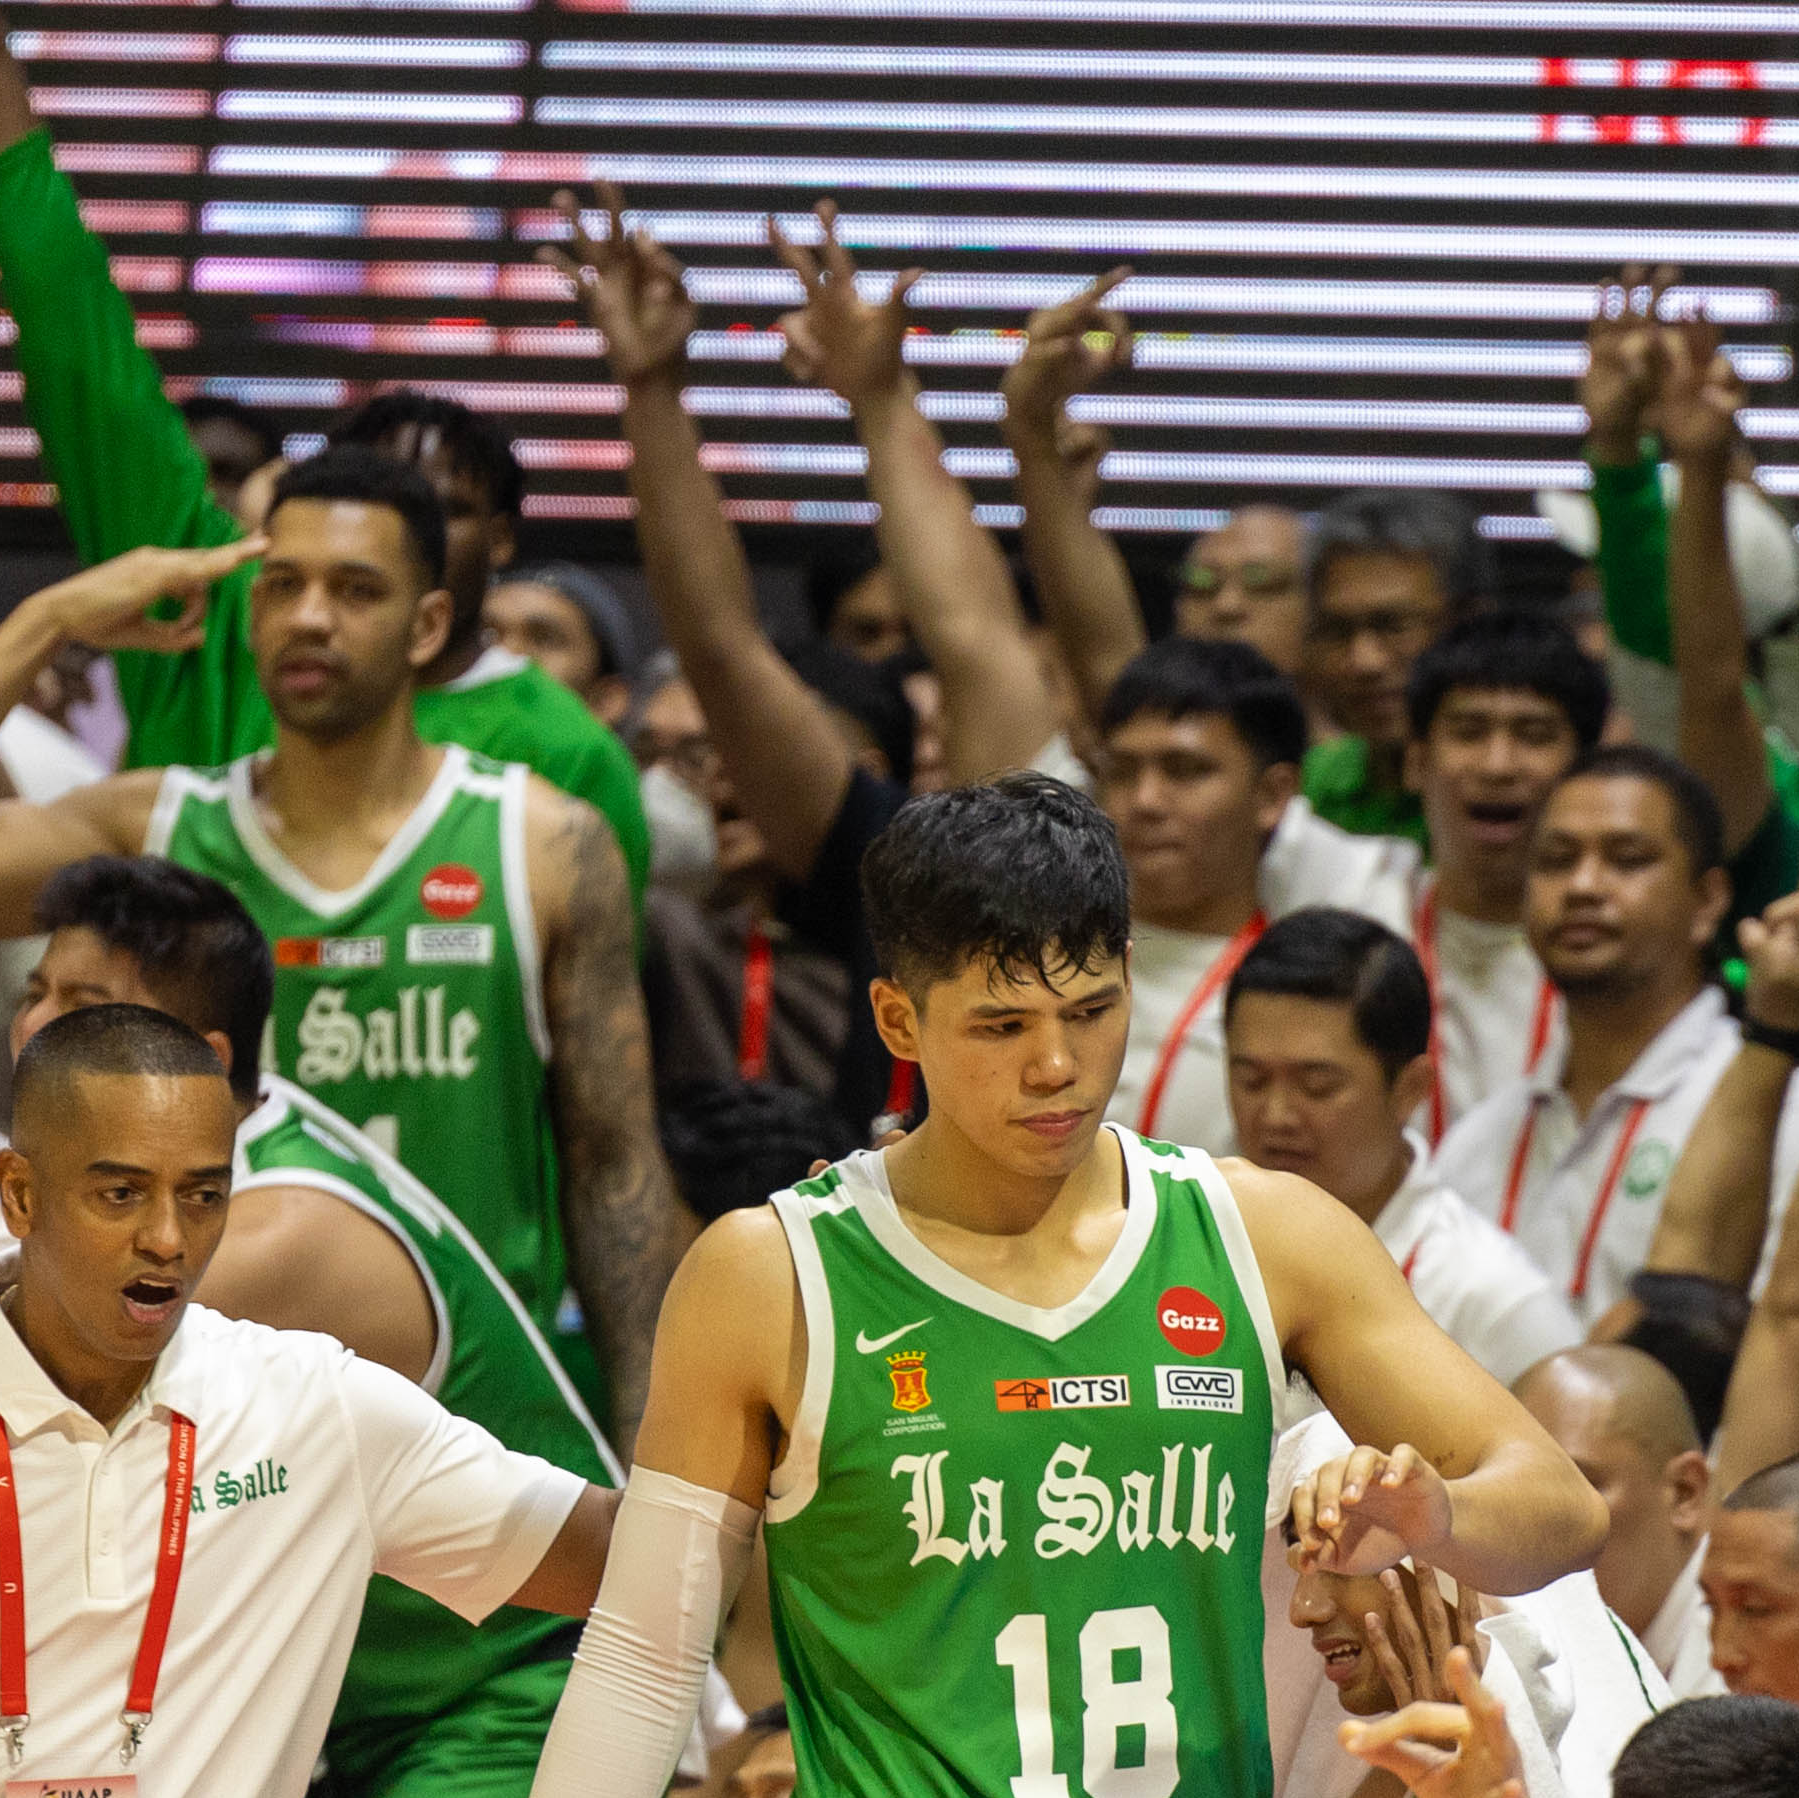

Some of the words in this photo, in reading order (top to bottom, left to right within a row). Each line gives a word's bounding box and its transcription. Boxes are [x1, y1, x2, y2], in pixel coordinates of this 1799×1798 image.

[296, 984, 481, 1085] Salle
[1162, 1309, 1220, 1332] Gazz
[1052, 1378, 1128, 1405] ICTSI
[1175, 1376, 1229, 1393] CWC
[1170, 1398, 1234, 1409] INTERIORS
[883, 1421, 946, 1437] CORPORATION
[886, 1417, 906, 1427] SAN
[214, 1457, 290, 1510] Salle
[889, 1449, 1008, 1568] La
[1034, 1441, 1237, 1560] Salle
[168, 1496, 184, 1556] PHILIPPINES
